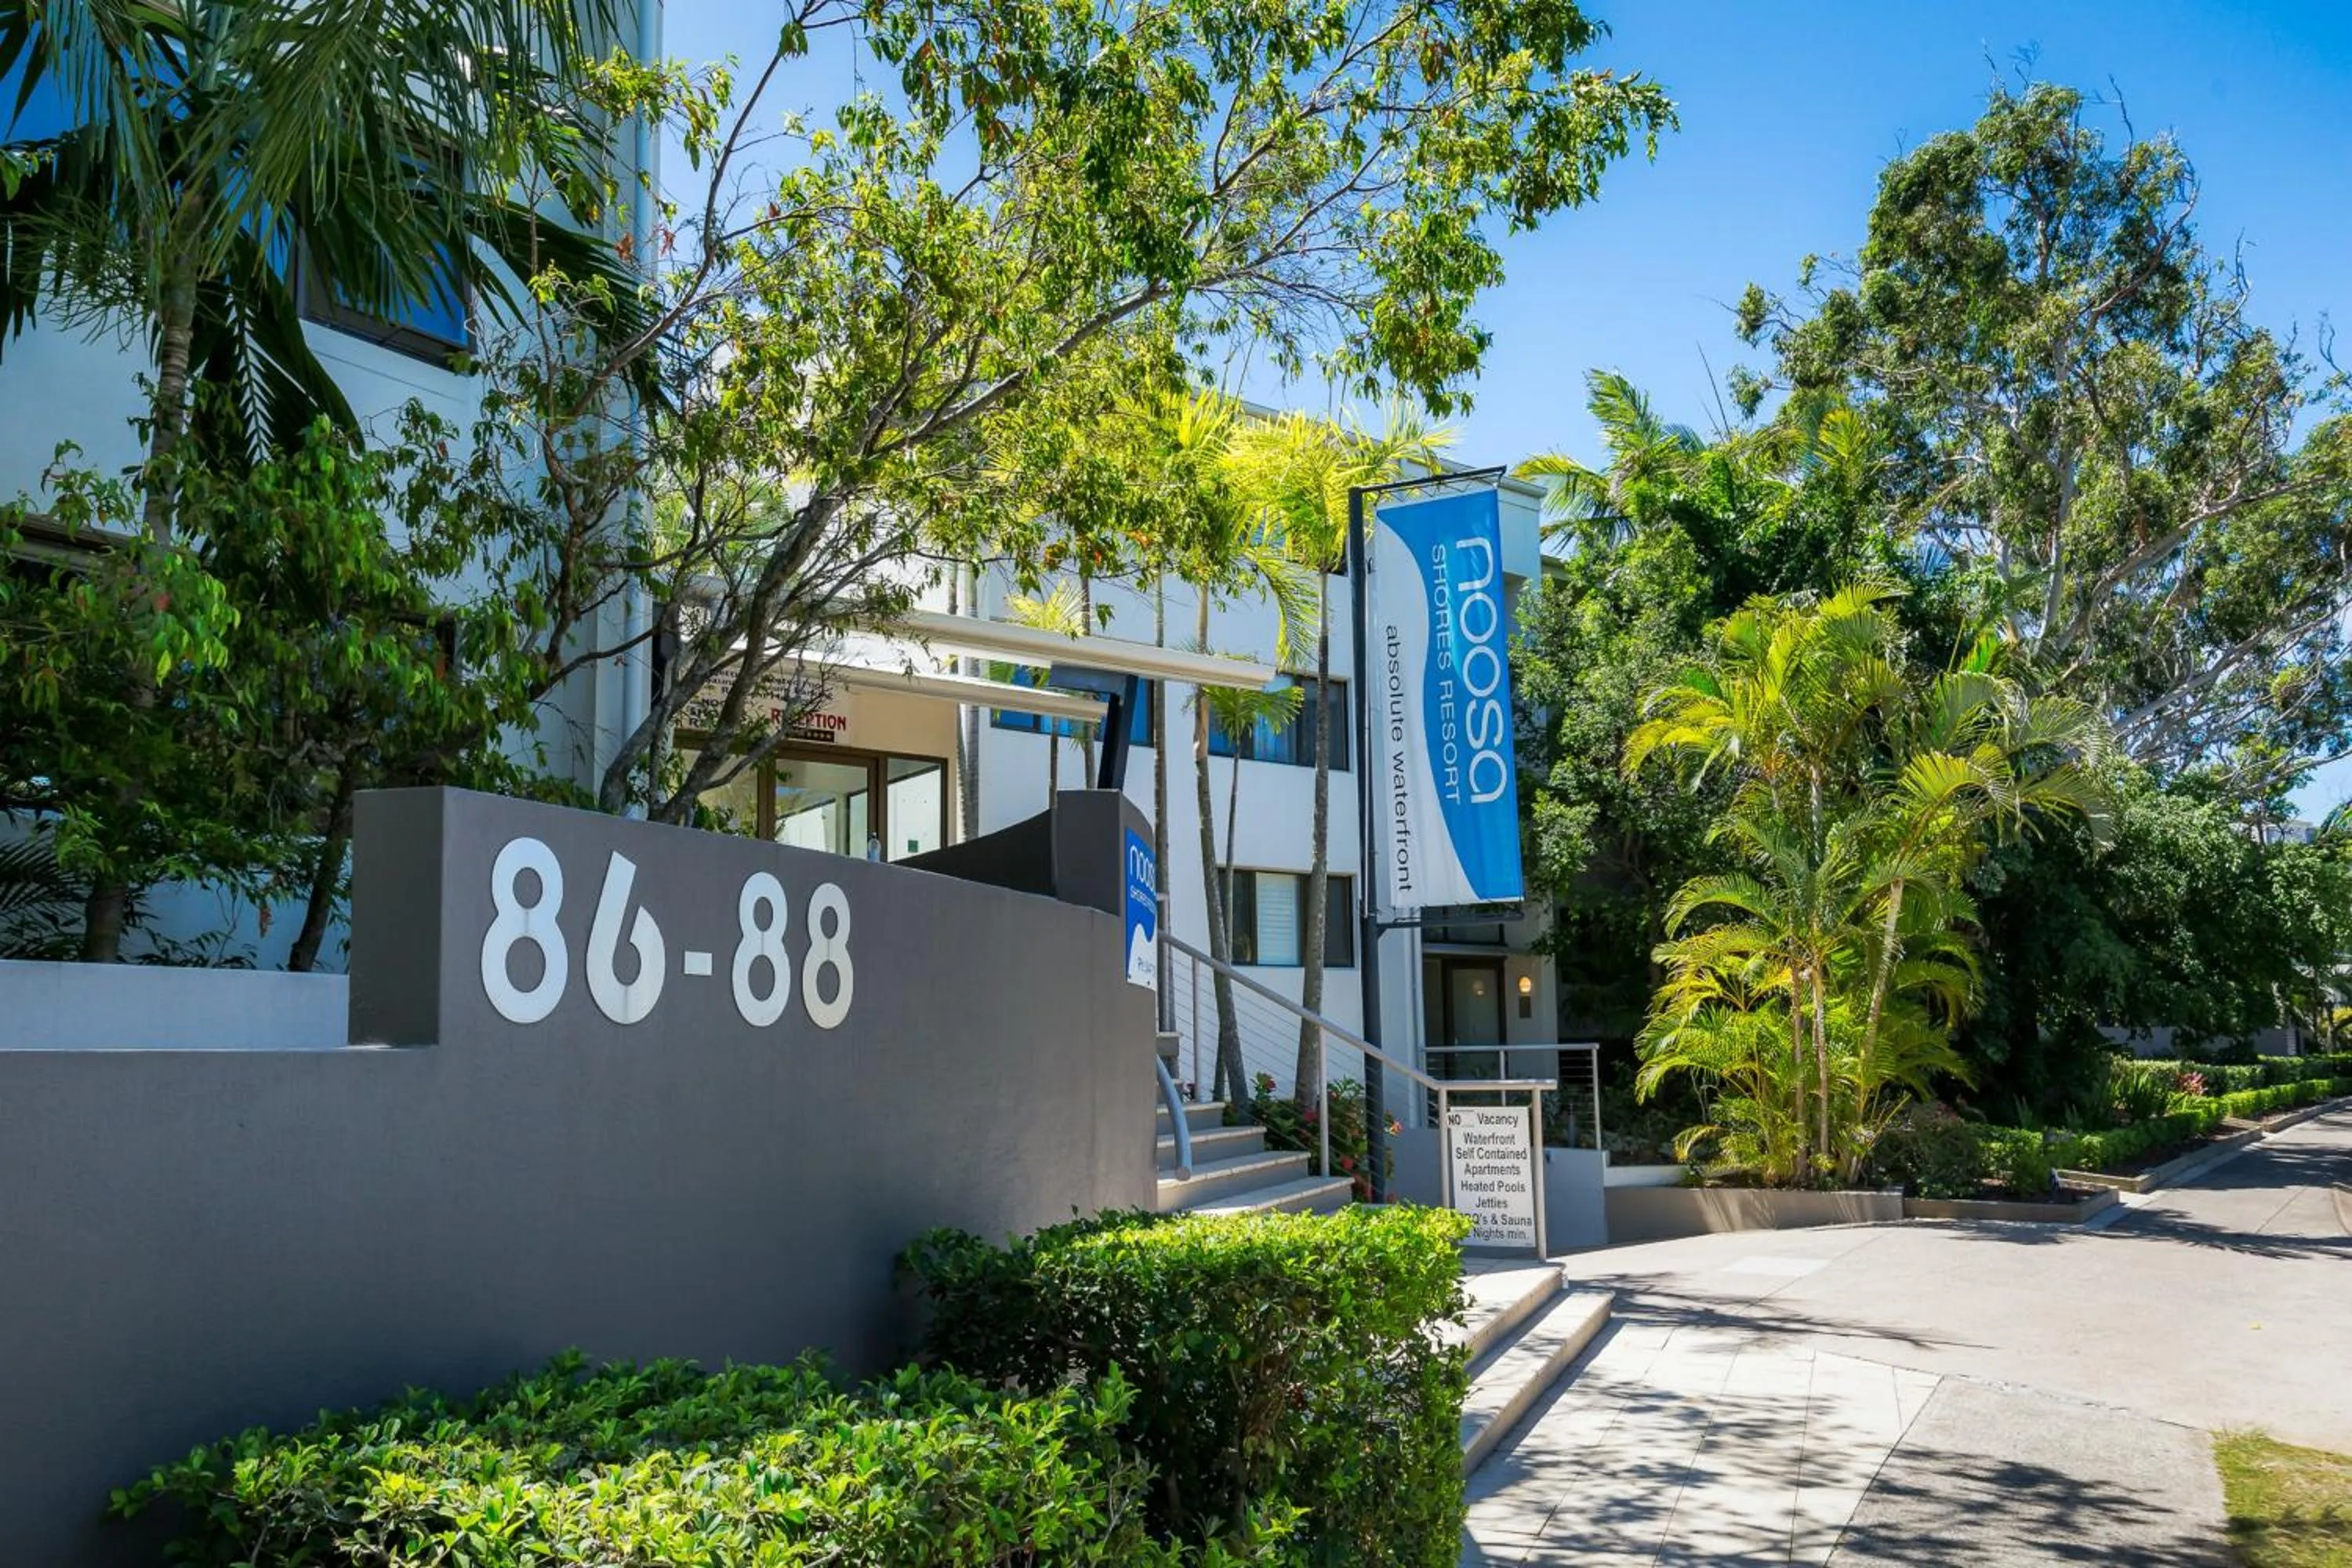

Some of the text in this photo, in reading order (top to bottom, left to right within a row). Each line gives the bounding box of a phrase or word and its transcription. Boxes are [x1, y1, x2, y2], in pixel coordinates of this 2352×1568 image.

[1432, 543, 1461, 805] SHORES RESORT
[1456, 536, 1508, 804] noosa
[1386, 625, 1412, 892] absolute waterfront
[481, 837, 854, 1029] 86-88
[1448, 1113, 1519, 1128] NO Vacancy
[1463, 1133, 1515, 1145] Waterfront
[1456, 1147, 1527, 1160] Self Contained
[1464, 1163, 1521, 1177] Apartments
[1461, 1181, 1526, 1192] Heated Pools
[1475, 1197, 1508, 1209] Jetties
[1490, 1213, 1497, 1225] &
[1501, 1214, 1532, 1226] Sauna
[1473, 1228, 1504, 1240] Nights
[1508, 1229, 1530, 1240] min.
